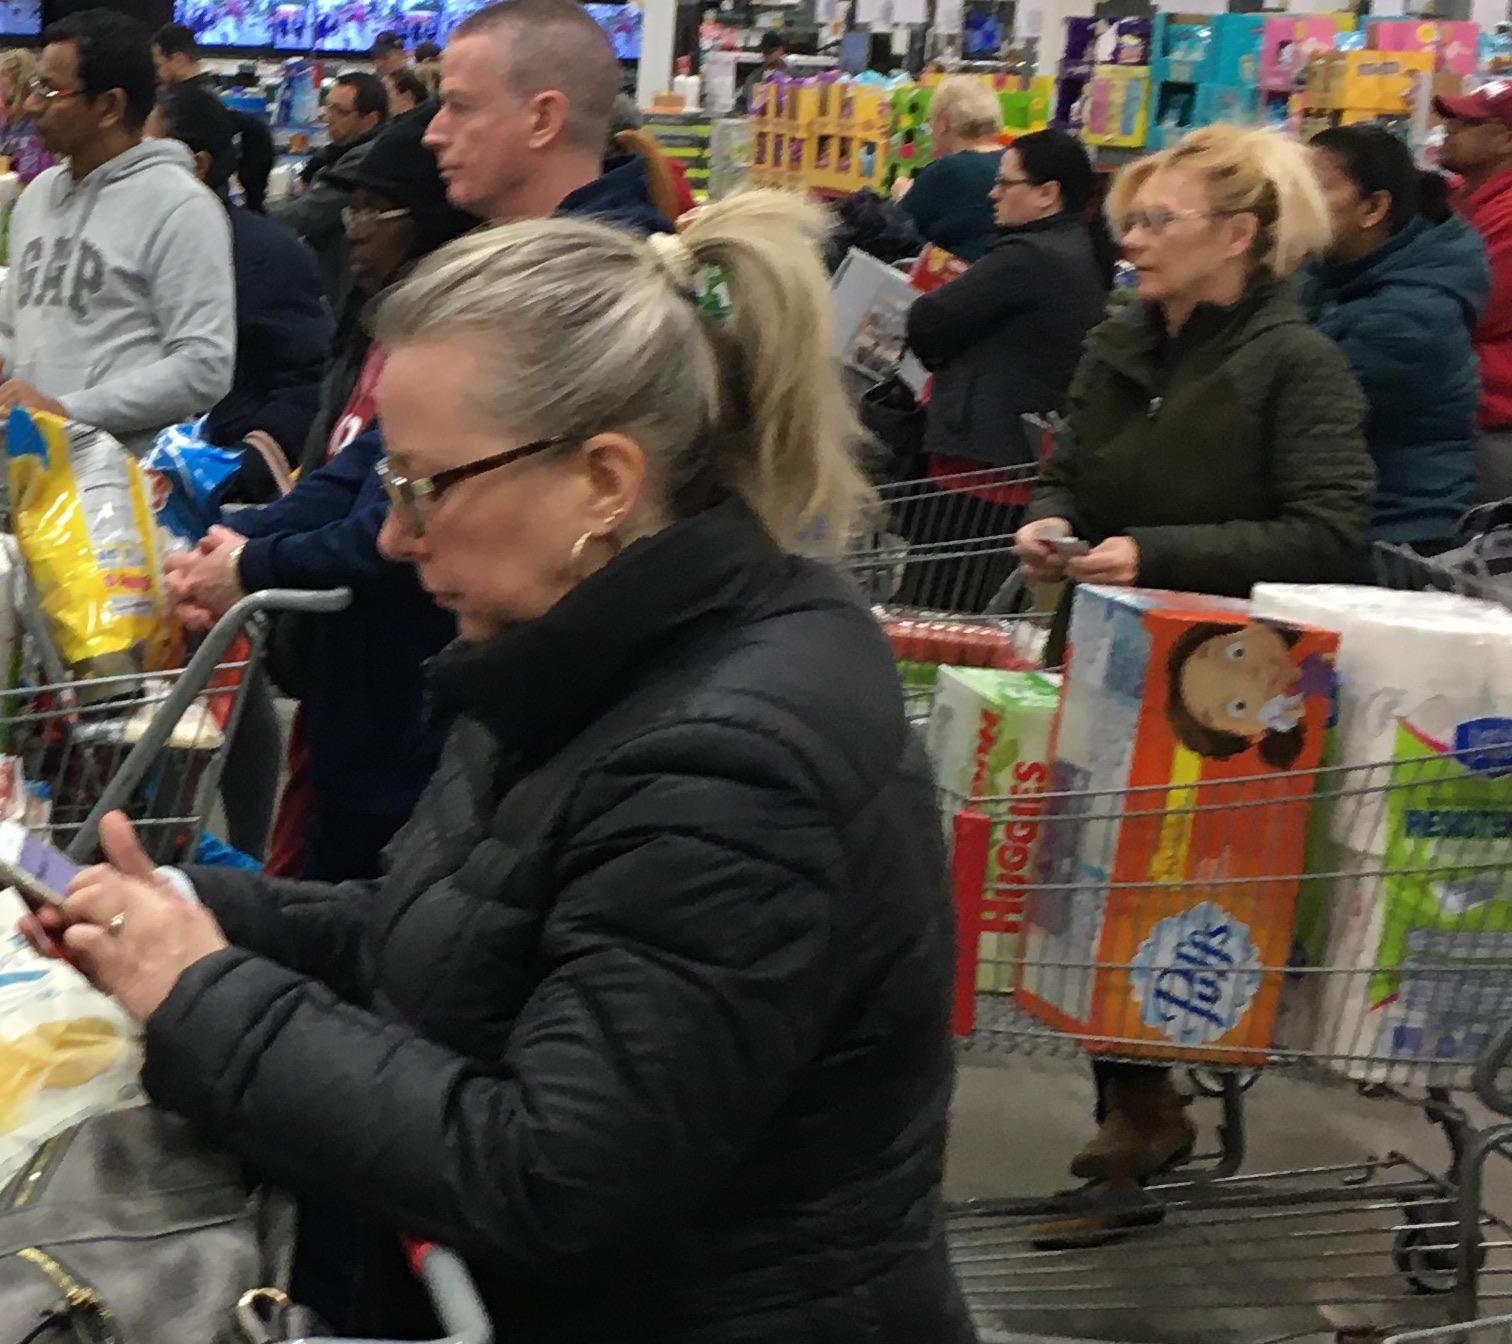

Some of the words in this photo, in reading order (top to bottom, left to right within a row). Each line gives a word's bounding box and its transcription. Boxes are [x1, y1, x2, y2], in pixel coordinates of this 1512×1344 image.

[17, 235, 105, 324] GAP
[979, 760, 1048, 934] HUGGIES
[1151, 922, 1236, 1028] Puffs
